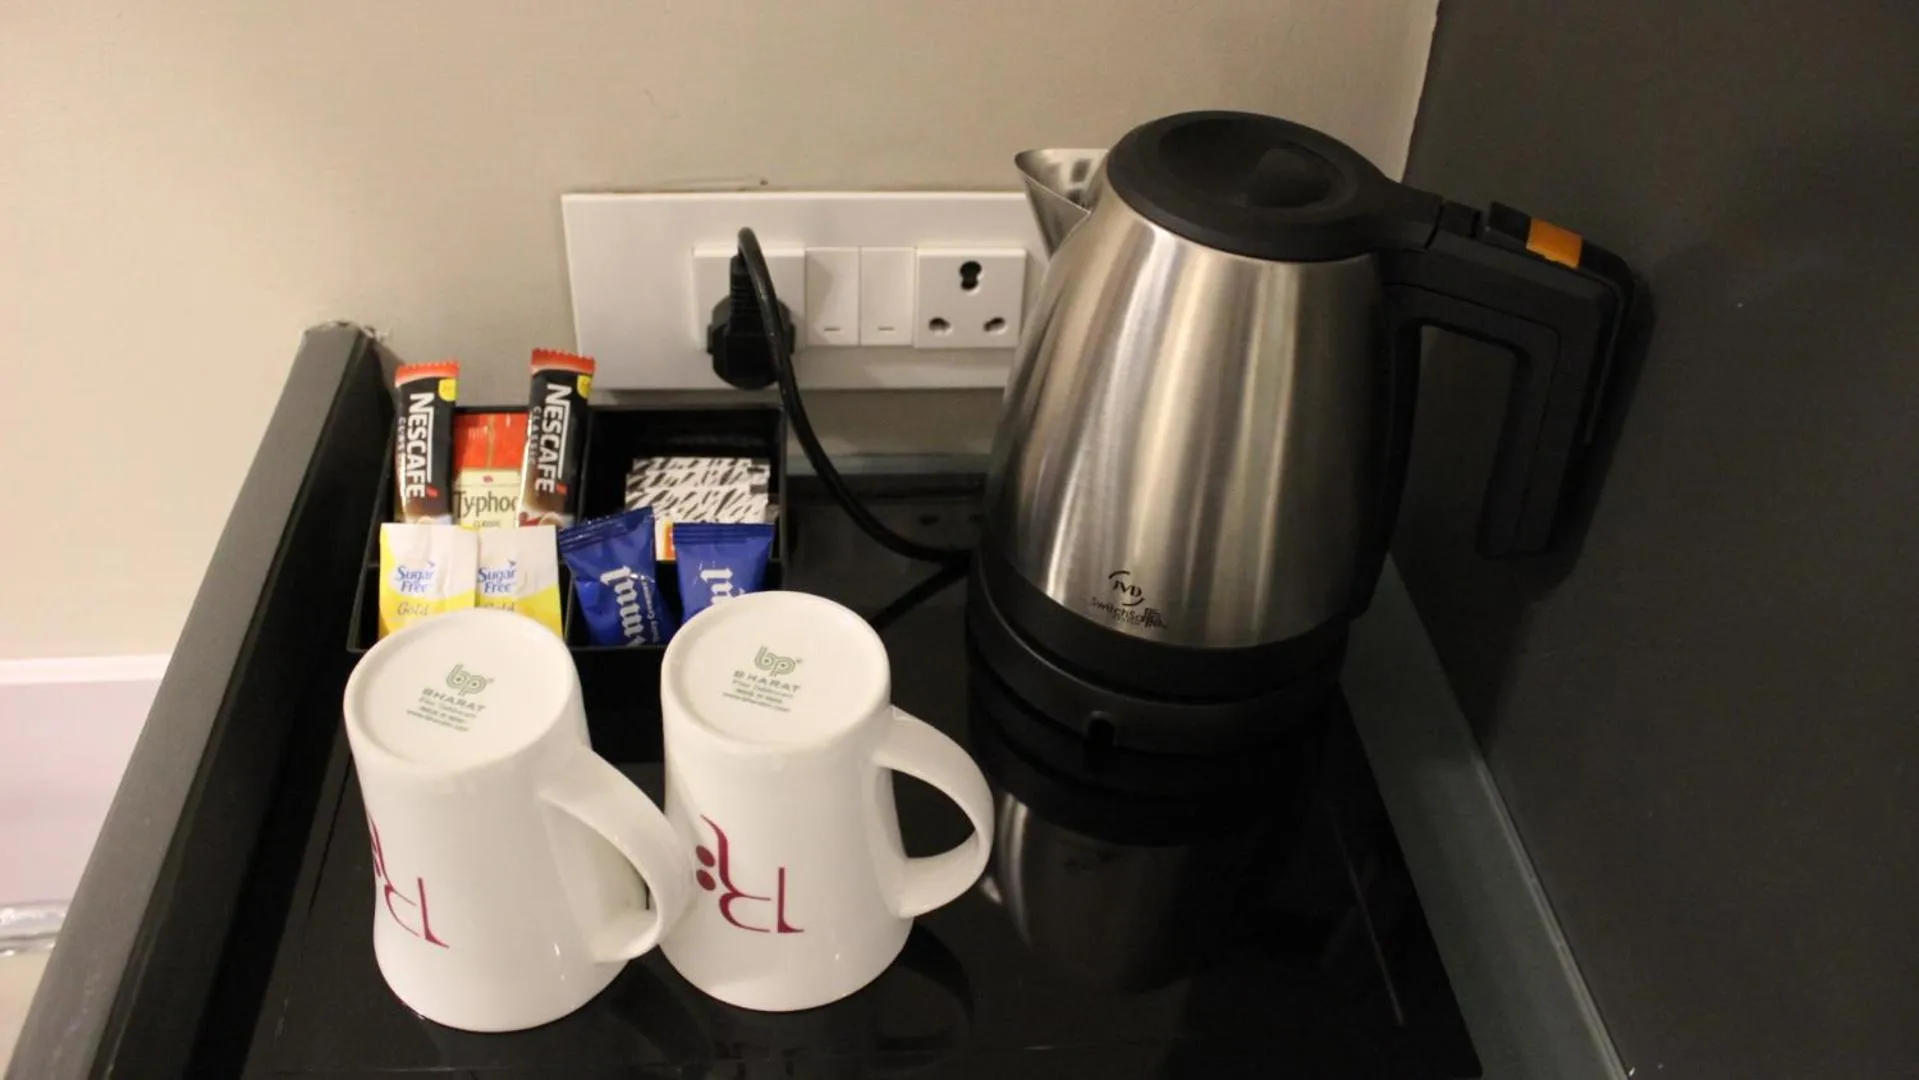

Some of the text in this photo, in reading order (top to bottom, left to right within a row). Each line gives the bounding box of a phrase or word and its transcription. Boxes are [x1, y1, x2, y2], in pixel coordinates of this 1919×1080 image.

[396, 565, 435, 582] Sugar
[478, 566, 516, 583] Sugar
[400, 580, 428, 593] Free
[484, 581, 512, 594] Free
[397, 602, 428, 616] Gold
